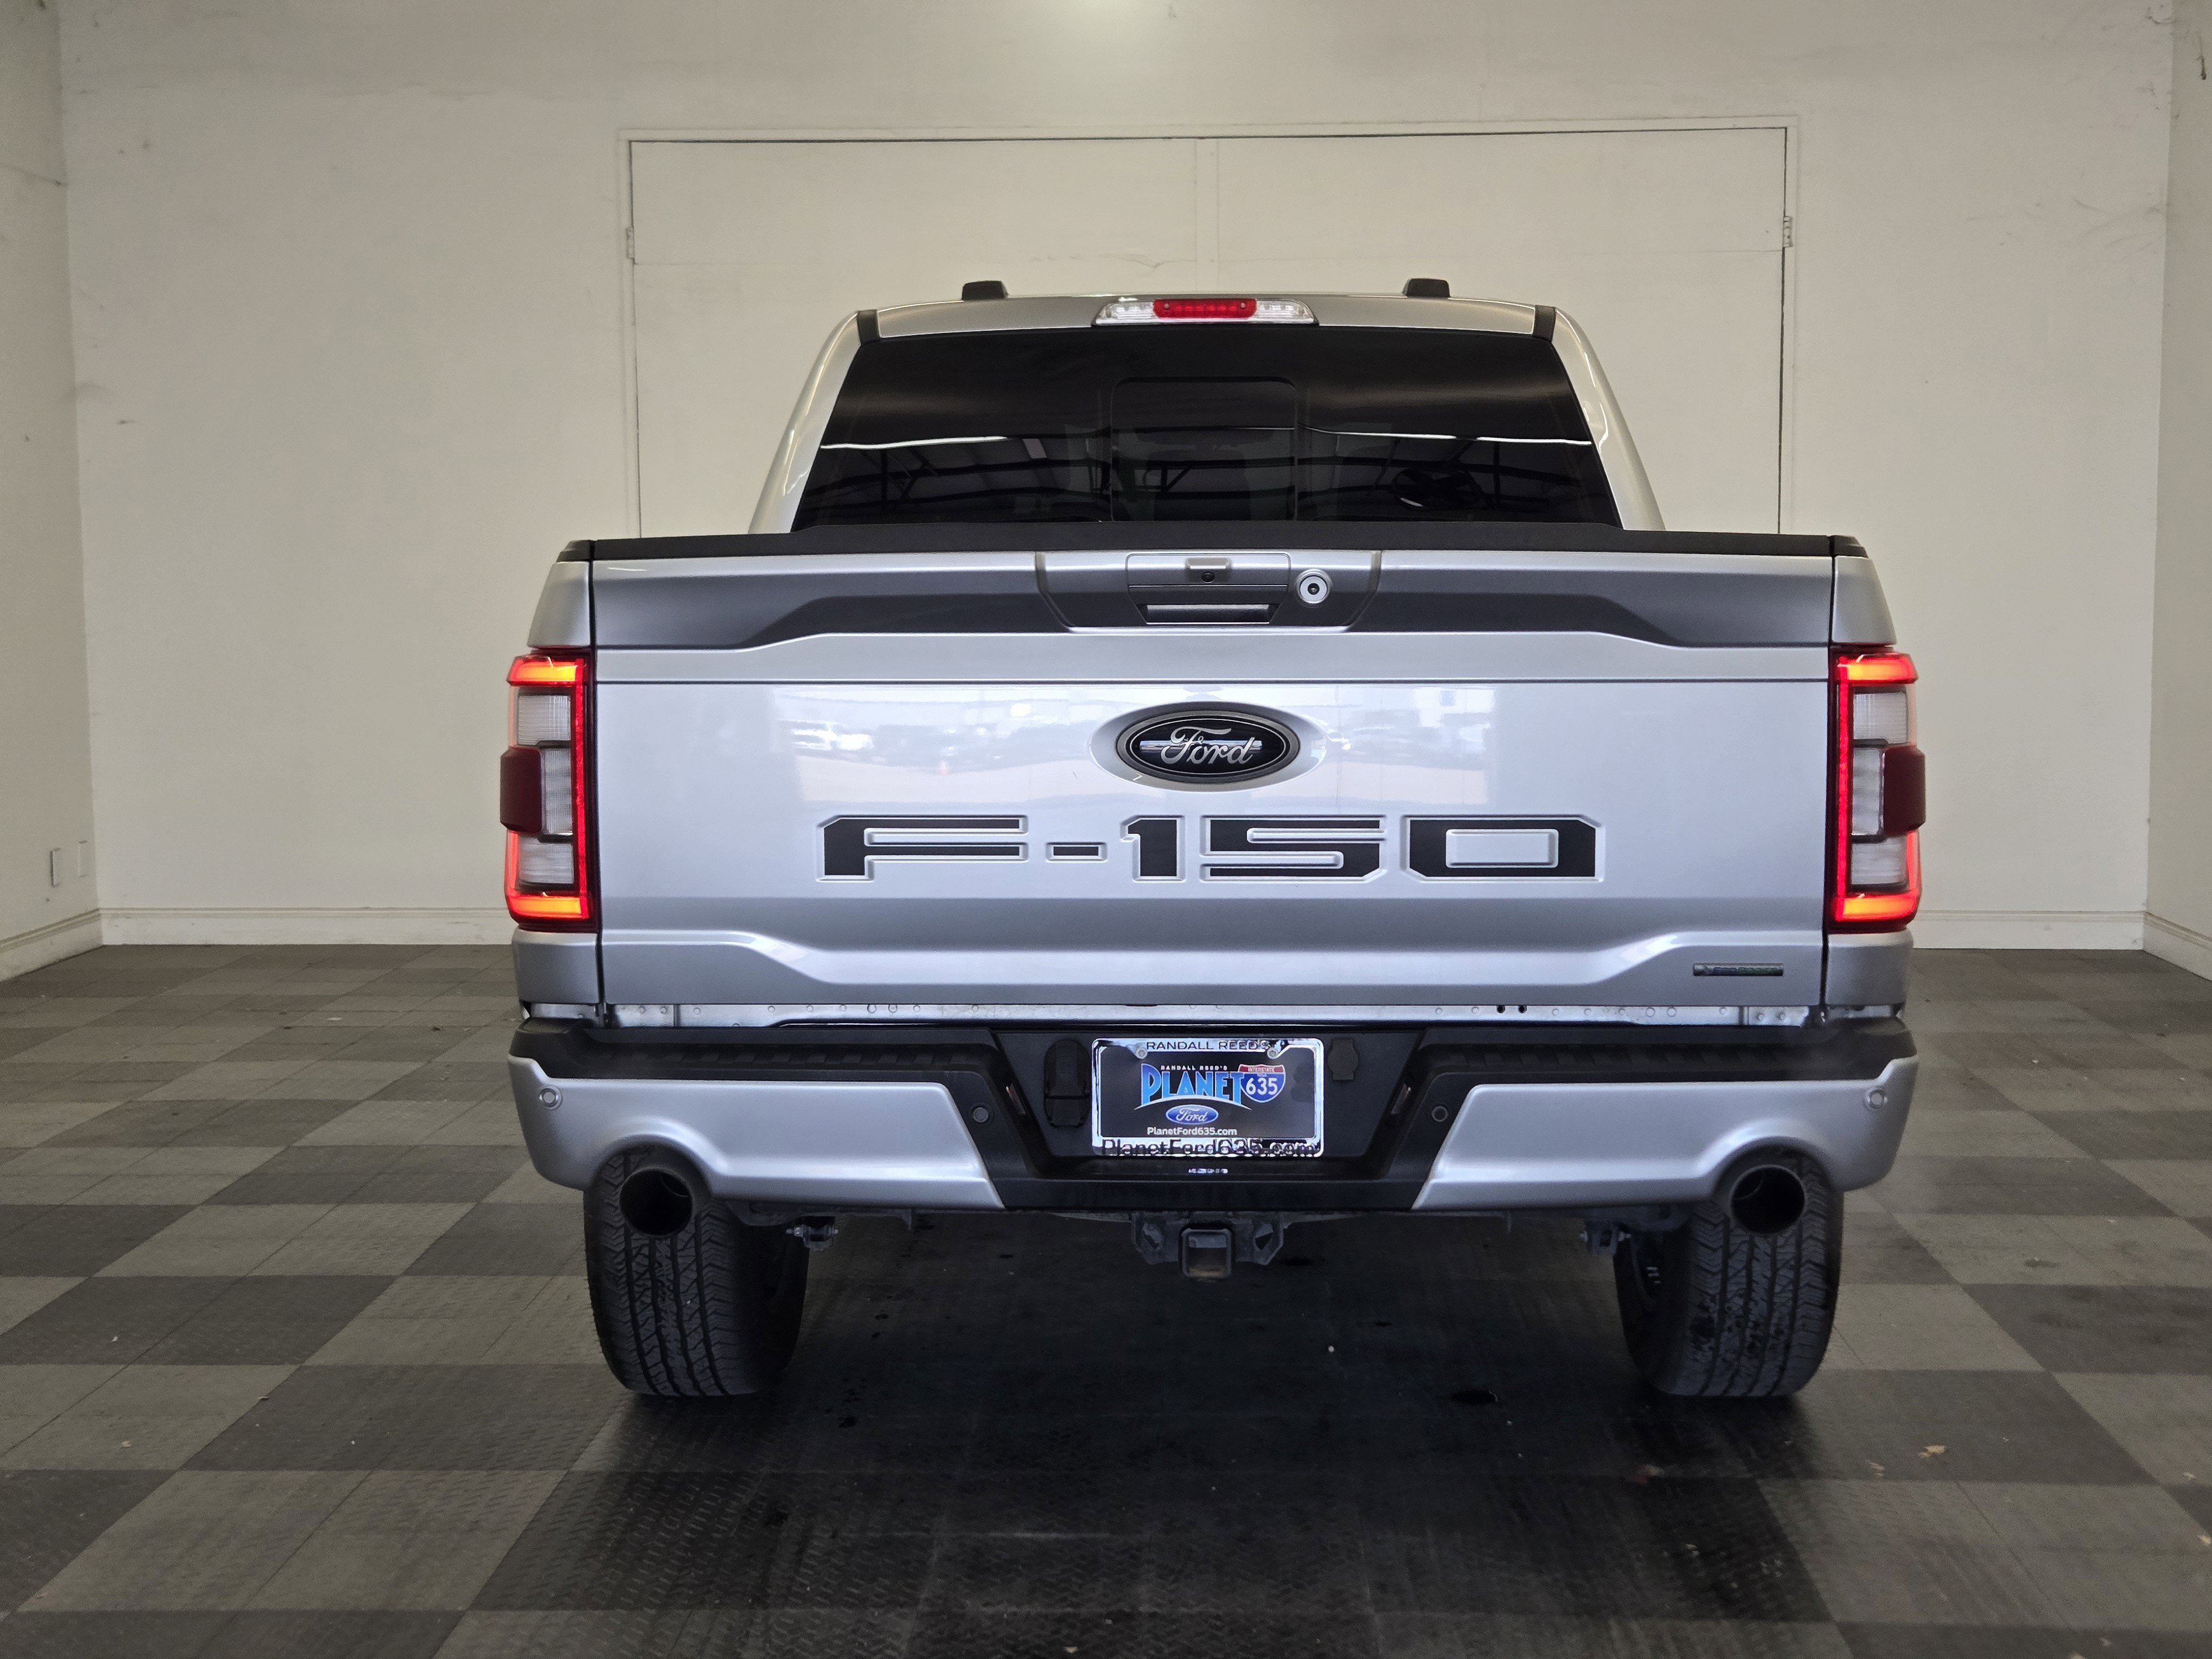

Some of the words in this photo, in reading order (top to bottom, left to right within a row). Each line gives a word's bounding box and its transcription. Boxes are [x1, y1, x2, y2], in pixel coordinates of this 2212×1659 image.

[1161, 726, 1256, 764] Ford
[817, 815, 1605, 883] F-150
[1146, 1041, 1214, 1050] RANDALL
[1141, 1063, 1245, 1106] PLANET
[1246, 1077, 1278, 1095] 635
[1176, 1108, 1208, 1122] Ford
[1147, 1127, 1237, 1135] PlanetFord635.com
